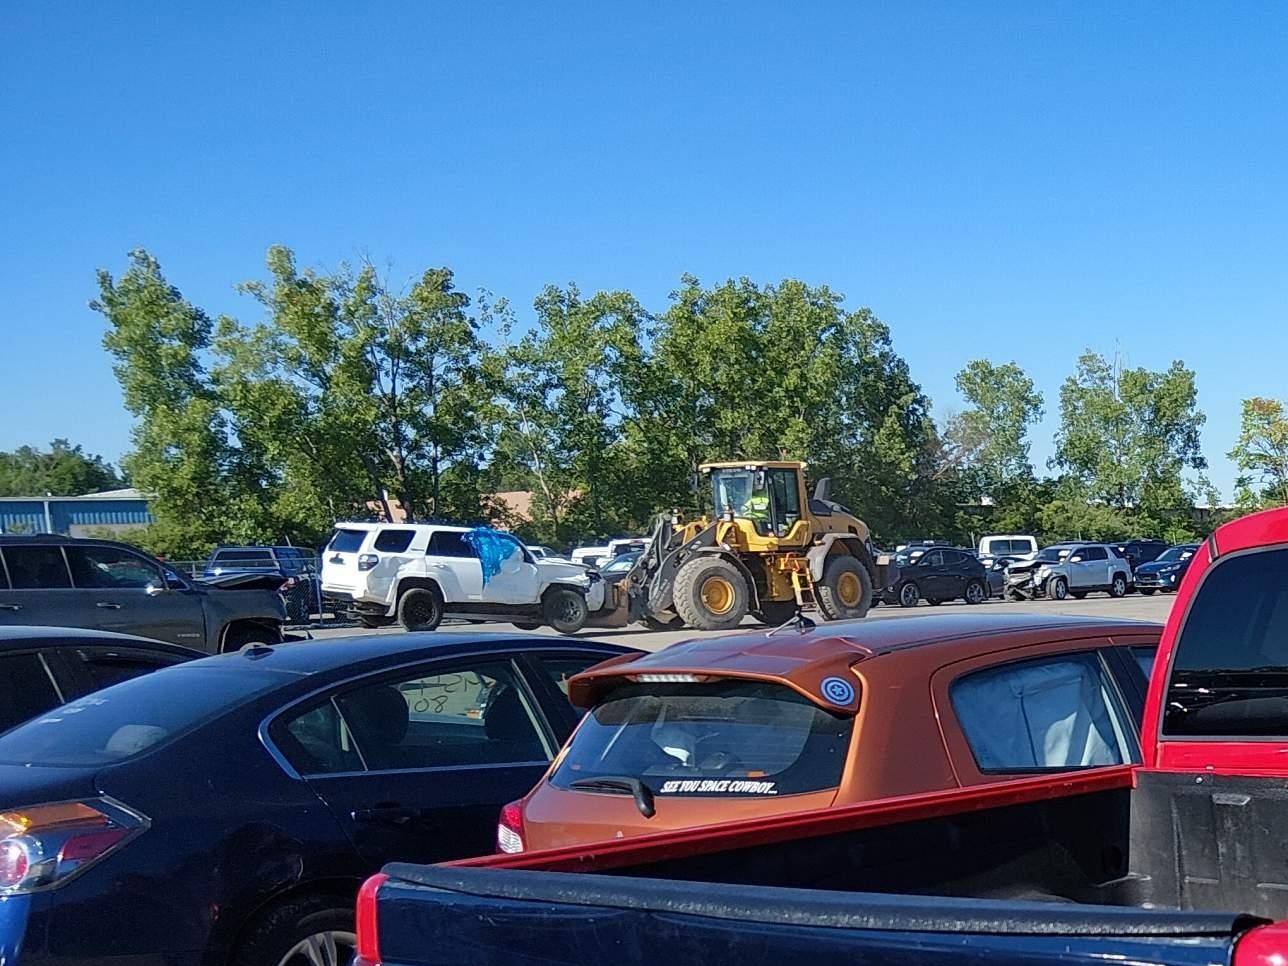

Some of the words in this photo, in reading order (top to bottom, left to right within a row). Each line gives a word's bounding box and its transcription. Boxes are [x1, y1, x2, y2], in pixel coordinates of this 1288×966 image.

[660, 781, 681, 792] SEE
[680, 781, 700, 792] YOU
[699, 781, 731, 792] SPACE
